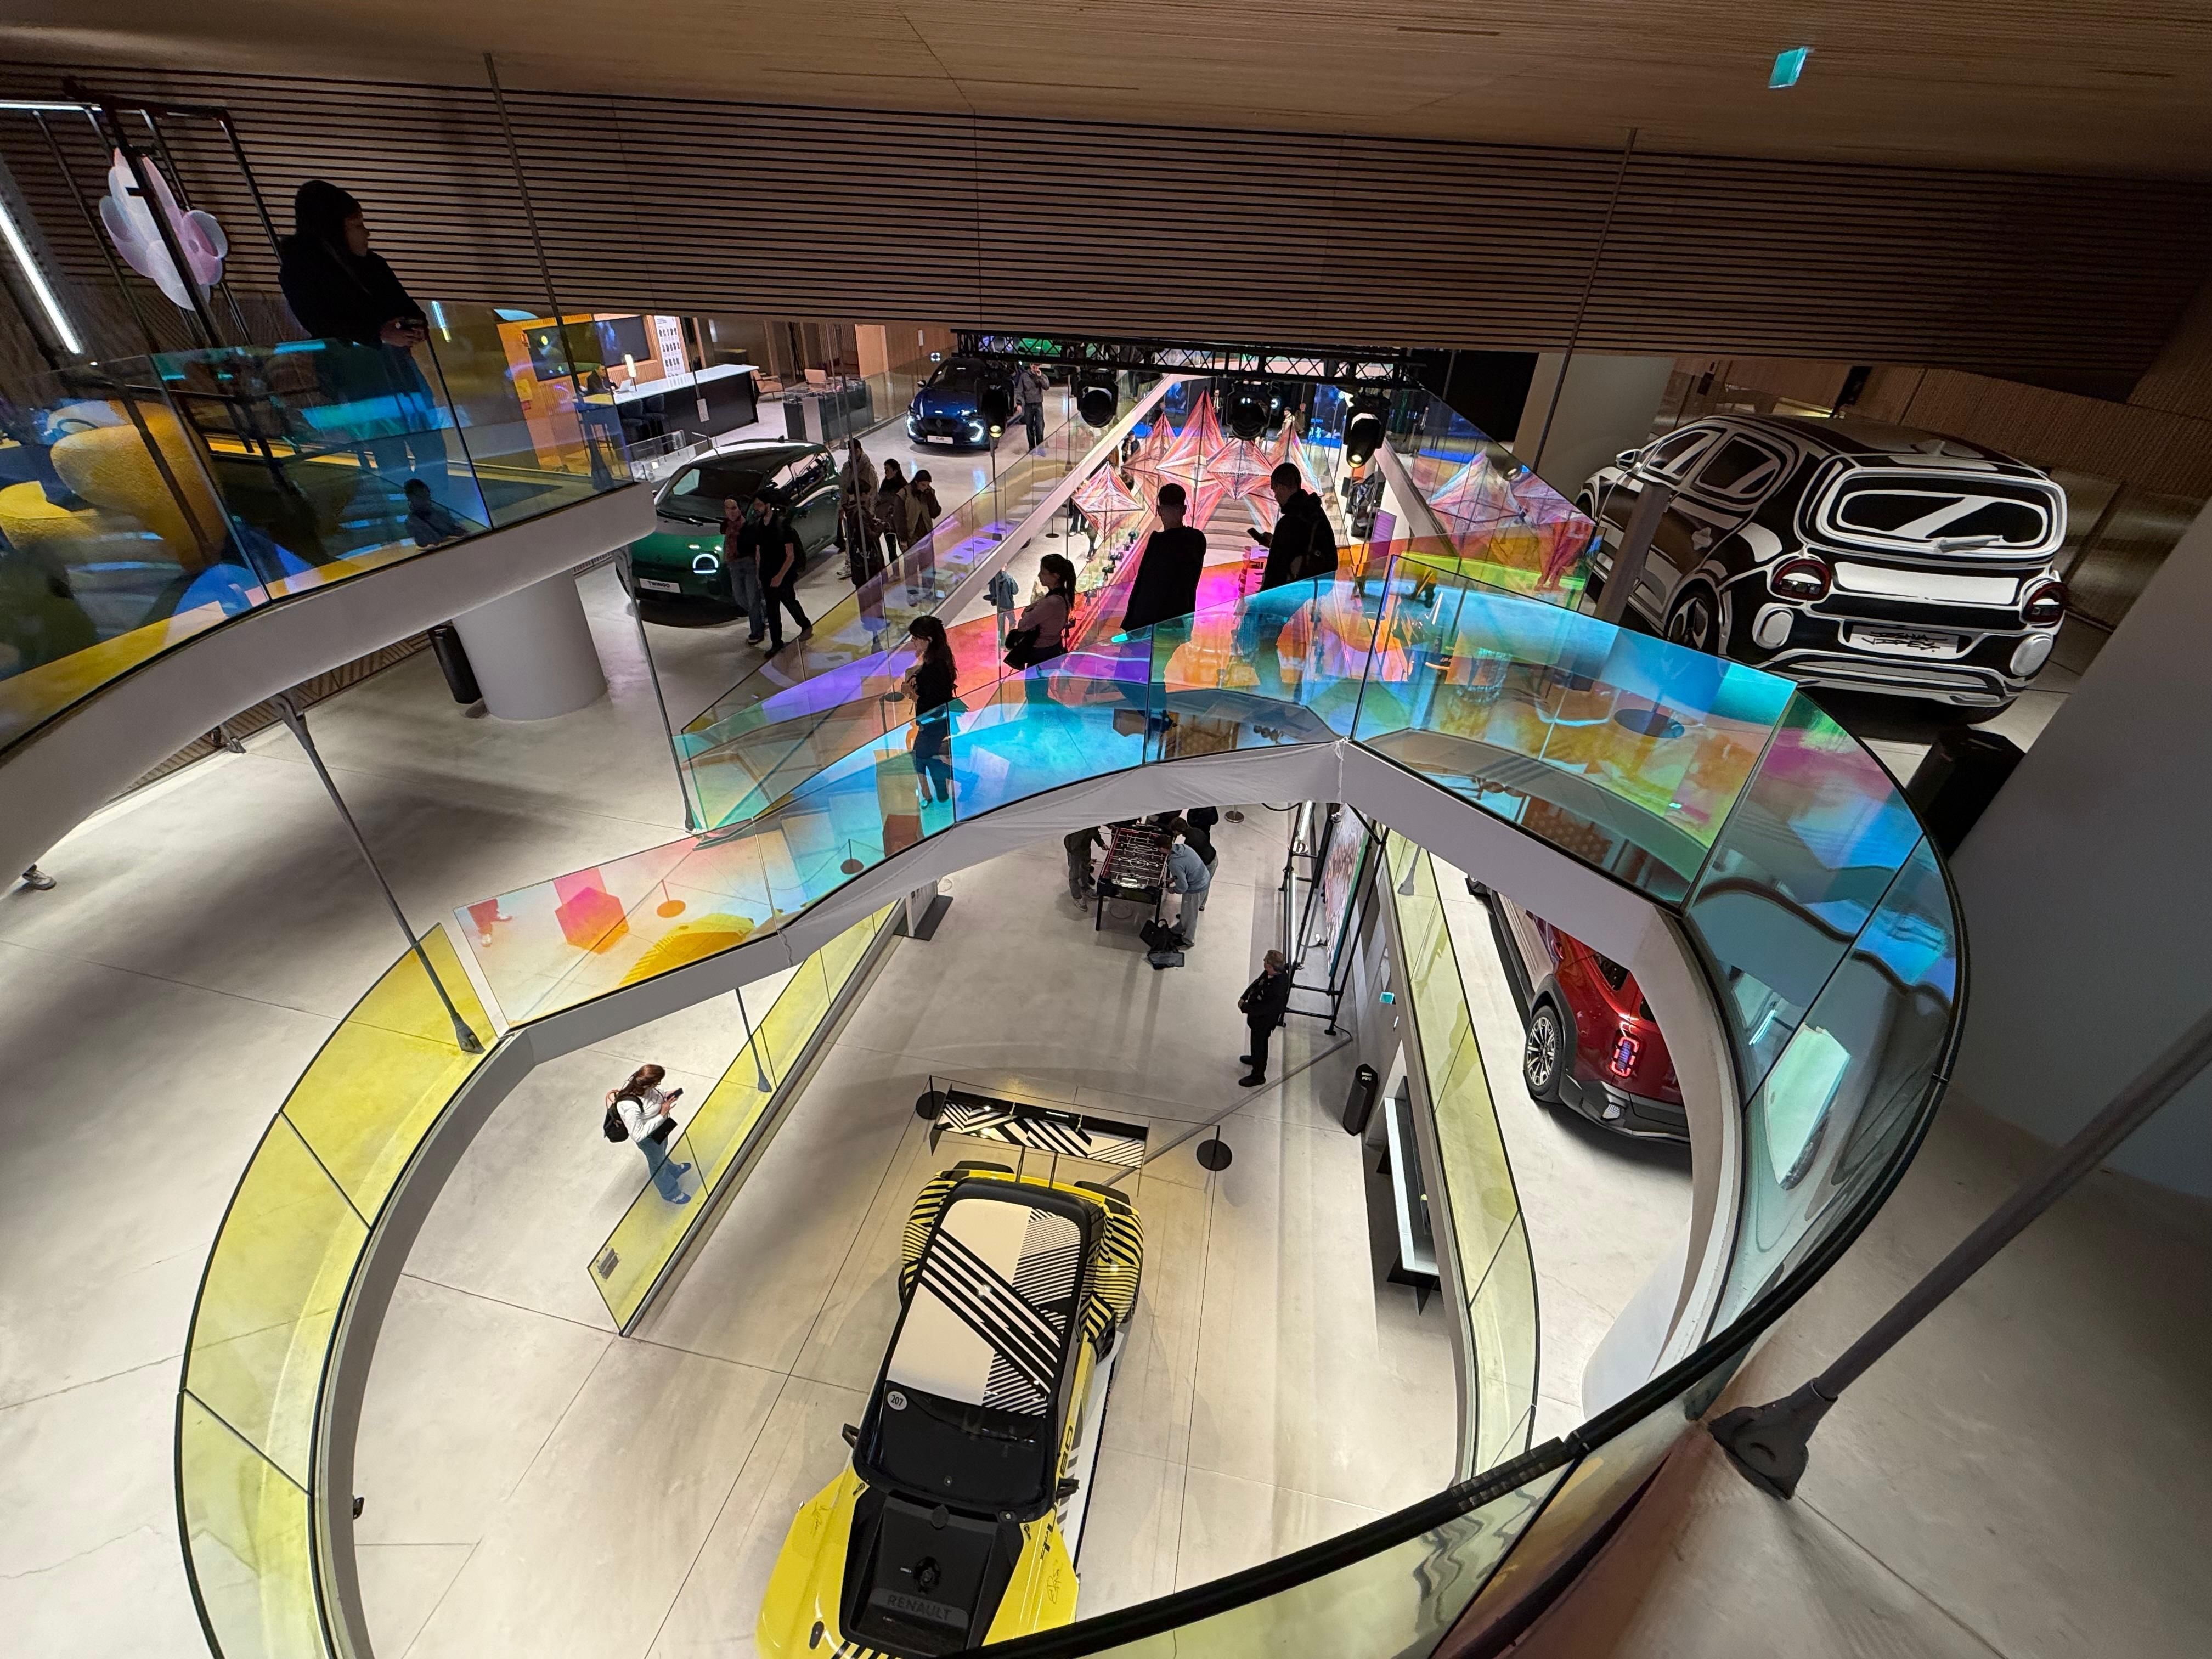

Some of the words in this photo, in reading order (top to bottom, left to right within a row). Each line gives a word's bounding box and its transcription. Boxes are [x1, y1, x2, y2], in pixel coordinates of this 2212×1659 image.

[890, 1395, 904, 1406] 207
[1040, 1425, 1073, 1559] TUBO
[888, 1594, 952, 1620] RENAULT
